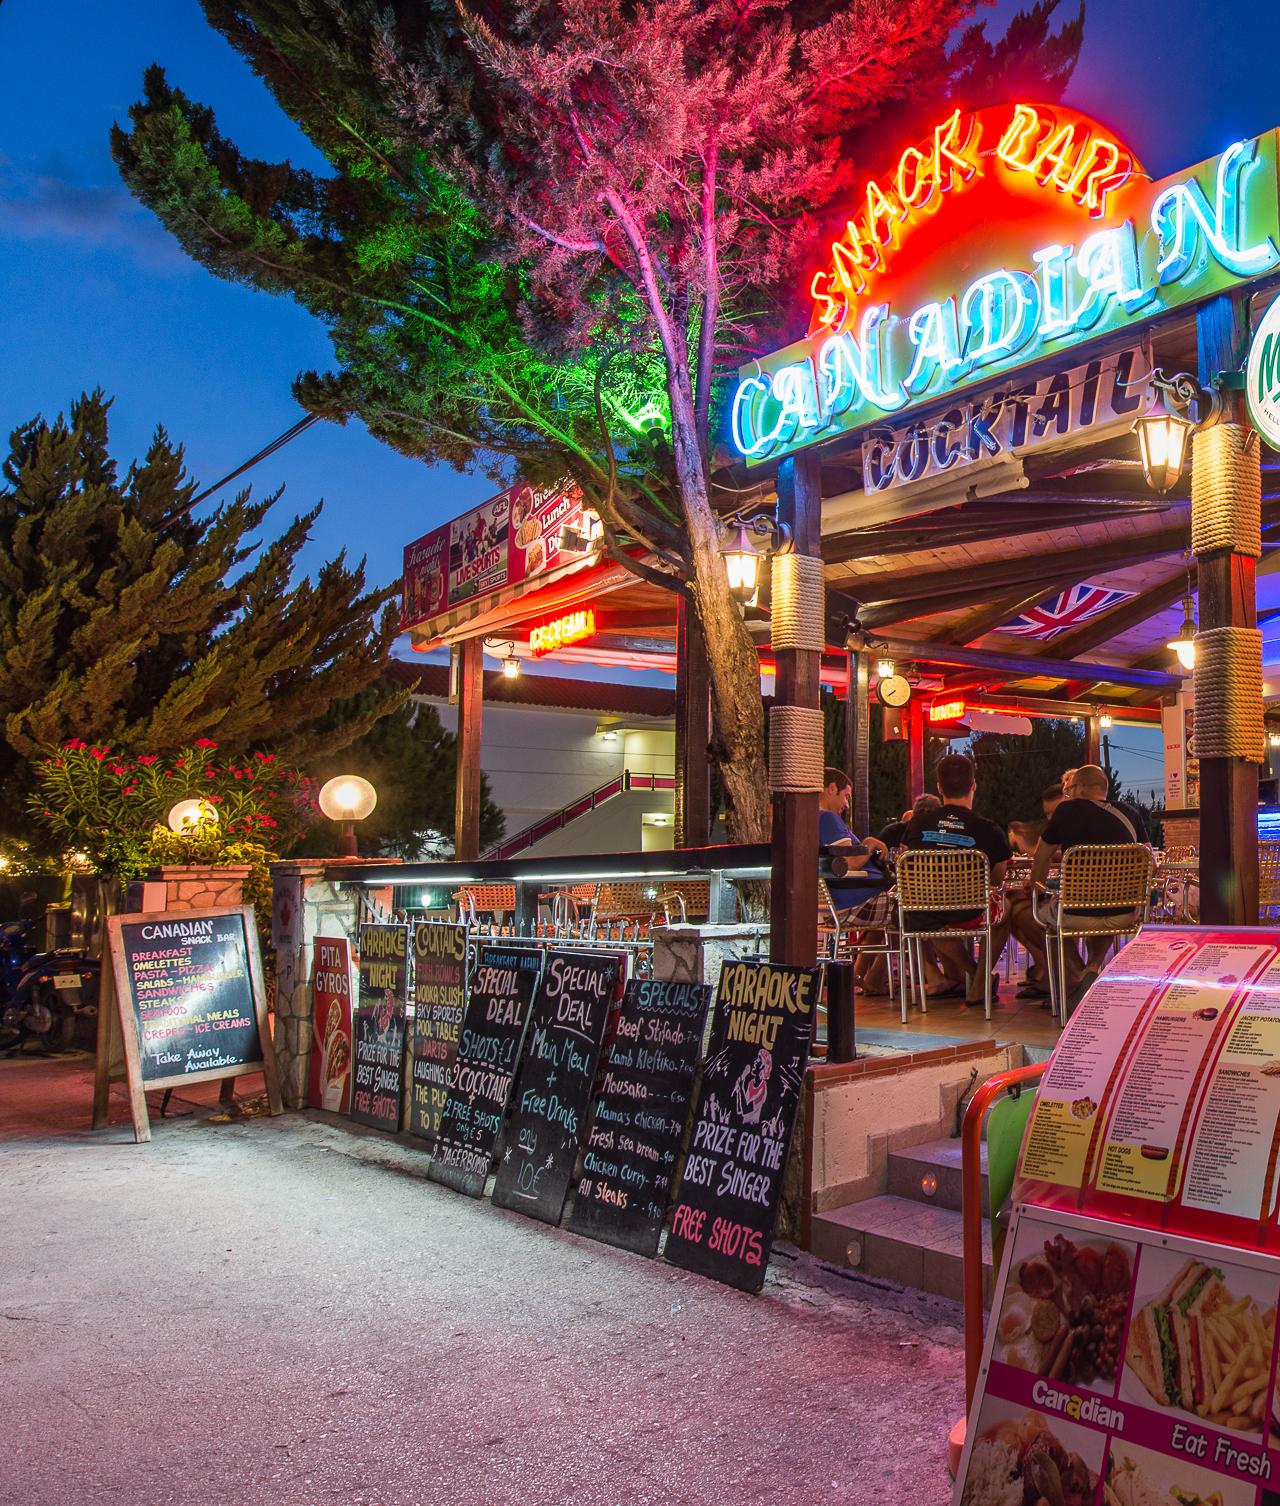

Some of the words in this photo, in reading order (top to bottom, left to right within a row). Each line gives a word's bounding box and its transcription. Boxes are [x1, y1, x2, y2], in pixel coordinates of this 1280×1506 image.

[810, 106, 981, 323] SNACK
[998, 104, 1134, 217] BAR
[732, 140, 1280, 459] CANADIAN
[865, 351, 1147, 492] COCKTAIL
[494, 500, 509, 516] AFL
[541, 496, 571, 530] Lunch
[407, 536, 447, 569] Karaoke
[456, 564, 471, 587] LIVE
[142, 920, 213, 940] CANADIAN
[181, 936, 212, 945] SNACK
[217, 934, 236, 943] BAR
[361, 926, 405, 958] KARAOKE
[415, 923, 465, 961] COCKTAILS
[132, 947, 193, 962] BREAKFAST
[133, 957, 192, 971] OMELETTES
[321, 946, 341, 968] PITA
[134, 970, 168, 981] PASTA
[178, 963, 214, 976] PIZZA
[136, 978, 174, 990] SALADS
[316, 971, 348, 996] GYROS
[369, 964, 397, 989] NIGHT
[474, 967, 519, 996] SPECIAL
[546, 958, 607, 998] SPECIAL
[137, 983, 215, 1000] SANDWICHES
[417, 985, 439, 1004] VODKA
[440, 985, 464, 1008] SLUSH
[638, 981, 700, 1011] SPECIALS
[719, 963, 813, 1014] KARAOKE
[139, 996, 185, 1010] STEAKS
[207, 1009, 239, 1021] MEALS
[416, 1003, 431, 1019] SKY
[432, 1006, 463, 1024] SPORTS
[486, 998, 522, 1026] DEAL
[556, 993, 592, 1031] DEAL
[144, 1027, 186, 1041] CREPES
[195, 1022, 211, 1034] ICE
[212, 1018, 251, 1030] CREAMS
[416, 1019, 433, 1037] POOL
[435, 1021, 459, 1042] TABLE
[616, 1016, 644, 1042] Beef
[645, 1017, 684, 1046] Stifado
[727, 1010, 784, 1051] NIGHT
[150, 1052, 182, 1065] Take
[186, 1047, 220, 1060] Away
[357, 1040, 376, 1063] PRIZE
[376, 1047, 388, 1065] FOR
[389, 1048, 400, 1068] THE
[422, 1040, 448, 1060] DARTS
[458, 1029, 500, 1062] SHOTS
[530, 1028, 559, 1067] Main
[561, 1037, 590, 1077] Meal
[608, 1043, 633, 1067] Lamb
[636, 1047, 676, 1074] Kleftiko
[357, 1064, 373, 1086] BEST
[414, 1060, 445, 1085] LAUGHING
[602, 1072, 647, 1099] Mousaka
[1218, 1069, 1251, 1077] SANDWICHES
[415, 1084, 428, 1104] THE
[458, 1067, 512, 1107] COCKTAILS
[355, 1091, 371, 1114] FREE
[372, 1093, 397, 1120] SHOTS
[452, 1101, 473, 1121] FREE
[474, 1110, 500, 1134] SHOTS
[520, 1088, 546, 1116] Free
[547, 1095, 578, 1133] Drinks
[595, 1100, 631, 1126] Mama's
[1039, 1101, 1064, 1110] OMELETTES
[419, 1110, 430, 1130] TO
[456, 1122, 469, 1140] only
[519, 1127, 538, 1155] only
[588, 1126, 614, 1149] Fresh
[693, 1120, 737, 1156] PRIZE
[736, 1131, 761, 1164] FOR
[761, 1137, 785, 1171] THE
[440, 1145, 490, 1177] JAGERBOMBS
[583, 1152, 617, 1177] Chicken
[620, 1164, 646, 1189] Curry
[578, 1178, 592, 1197] All
[595, 1181, 628, 1209] Steaks
[683, 1153, 717, 1187] BEST
[717, 1160, 771, 1207] SINGER
[672, 1204, 707, 1243] FREE
[708, 1217, 764, 1266] SHOTS
[1031, 1379, 1126, 1433] Canadian
[1170, 1423, 1209, 1460] Eat
[1213, 1439, 1273, 1481] Fresh
